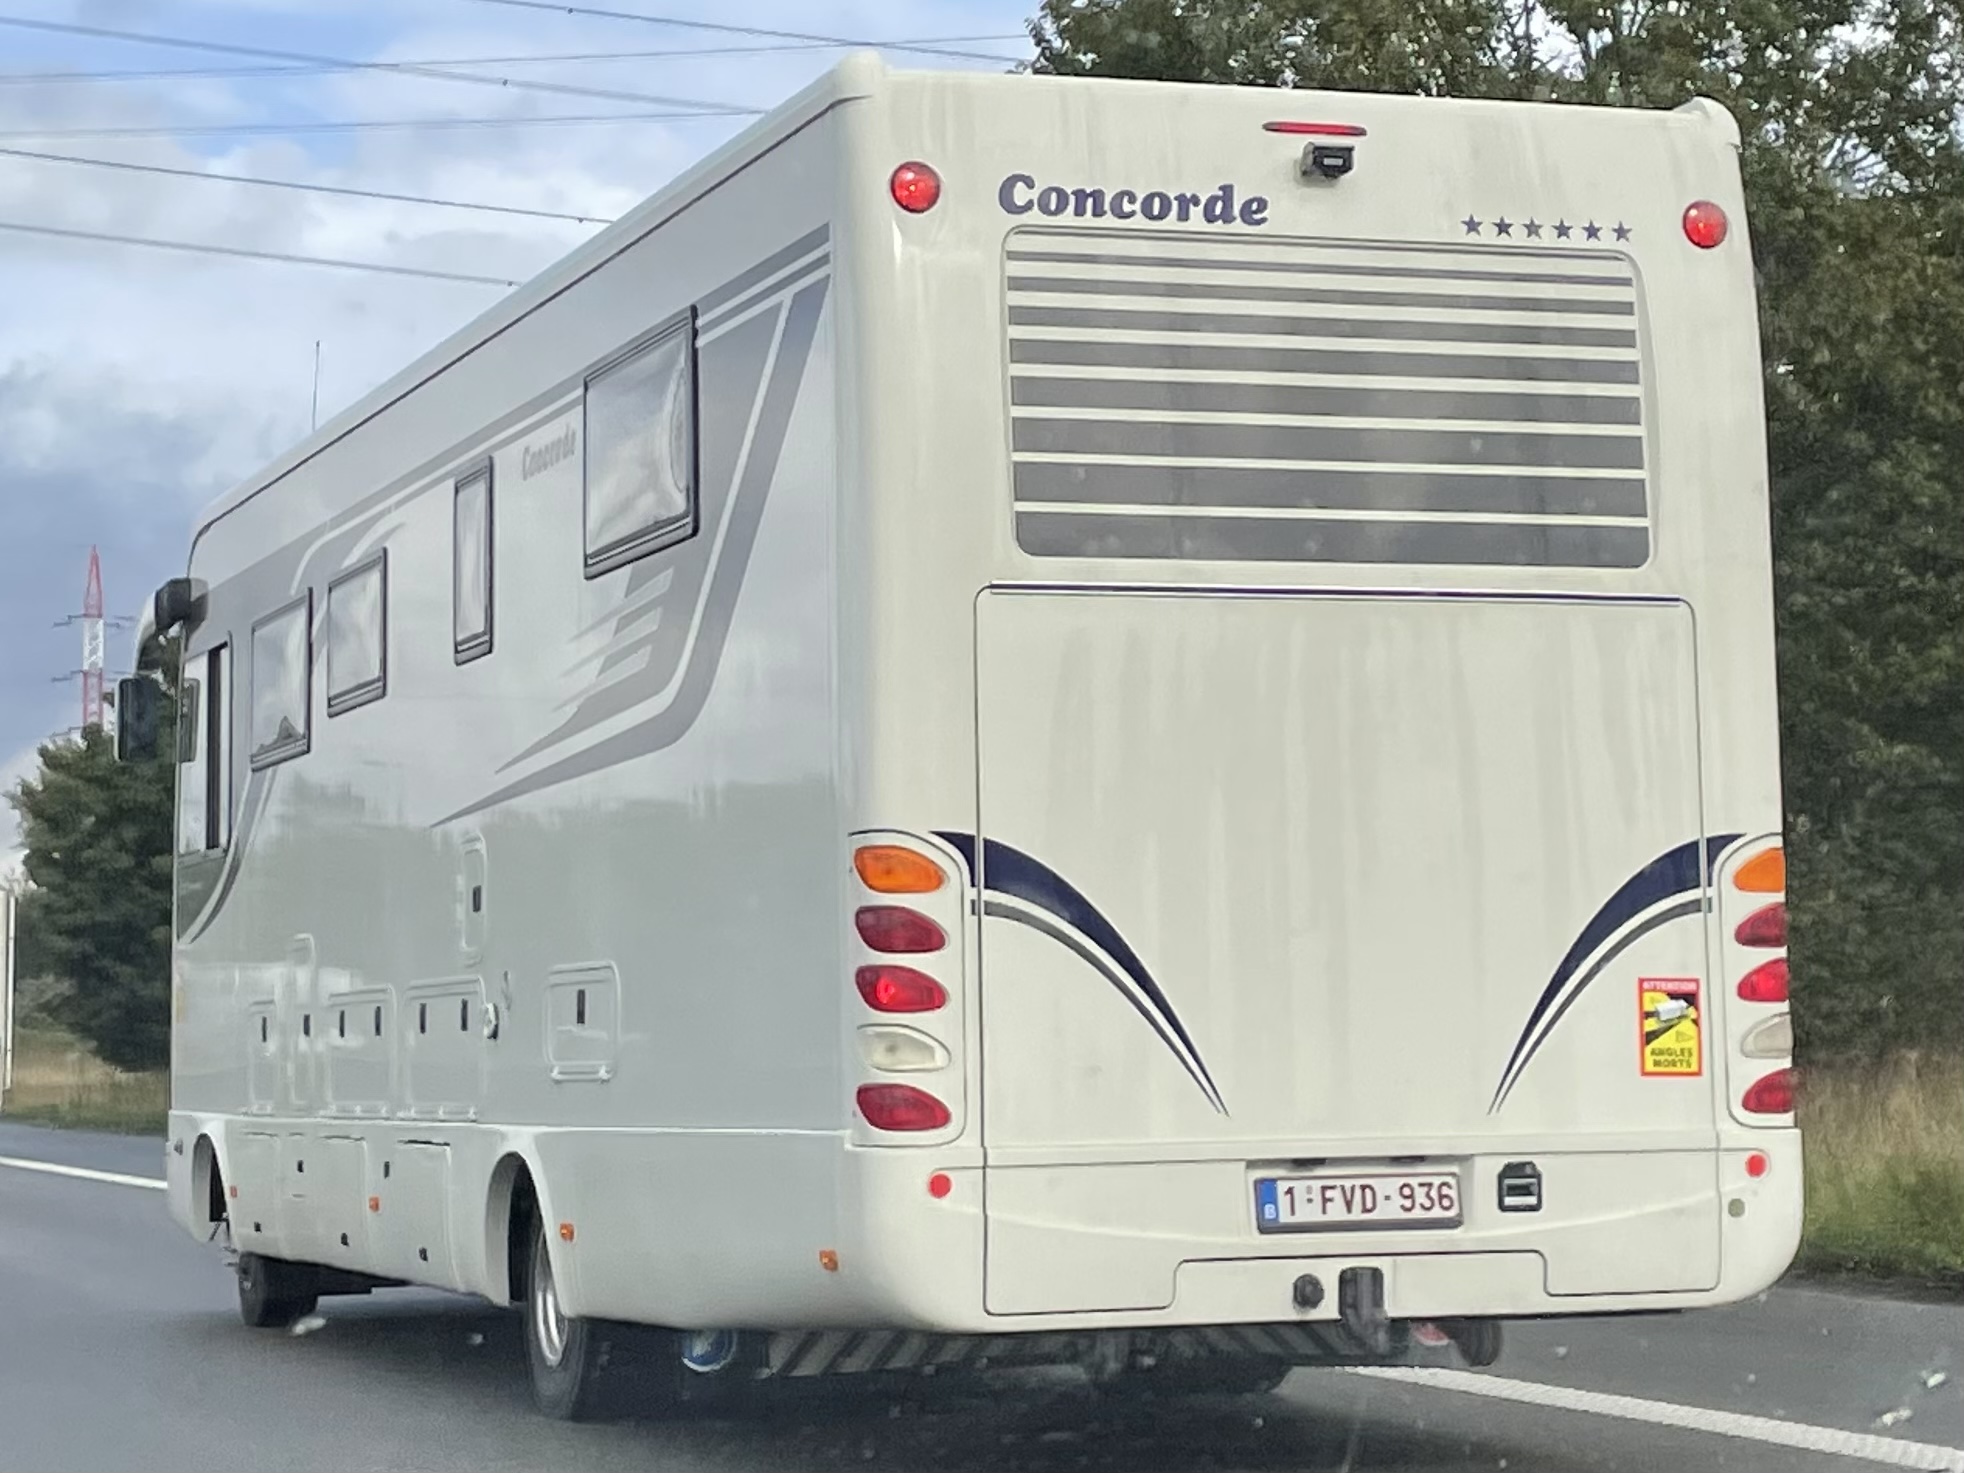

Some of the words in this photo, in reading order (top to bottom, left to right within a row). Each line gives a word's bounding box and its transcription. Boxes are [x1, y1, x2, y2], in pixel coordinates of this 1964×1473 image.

[998, 173, 1269, 226] Concorde
[1650, 1047, 1693, 1057] ANGLES
[1653, 1058, 1692, 1068] MORTS
[1264, 1203, 1277, 1219] B
